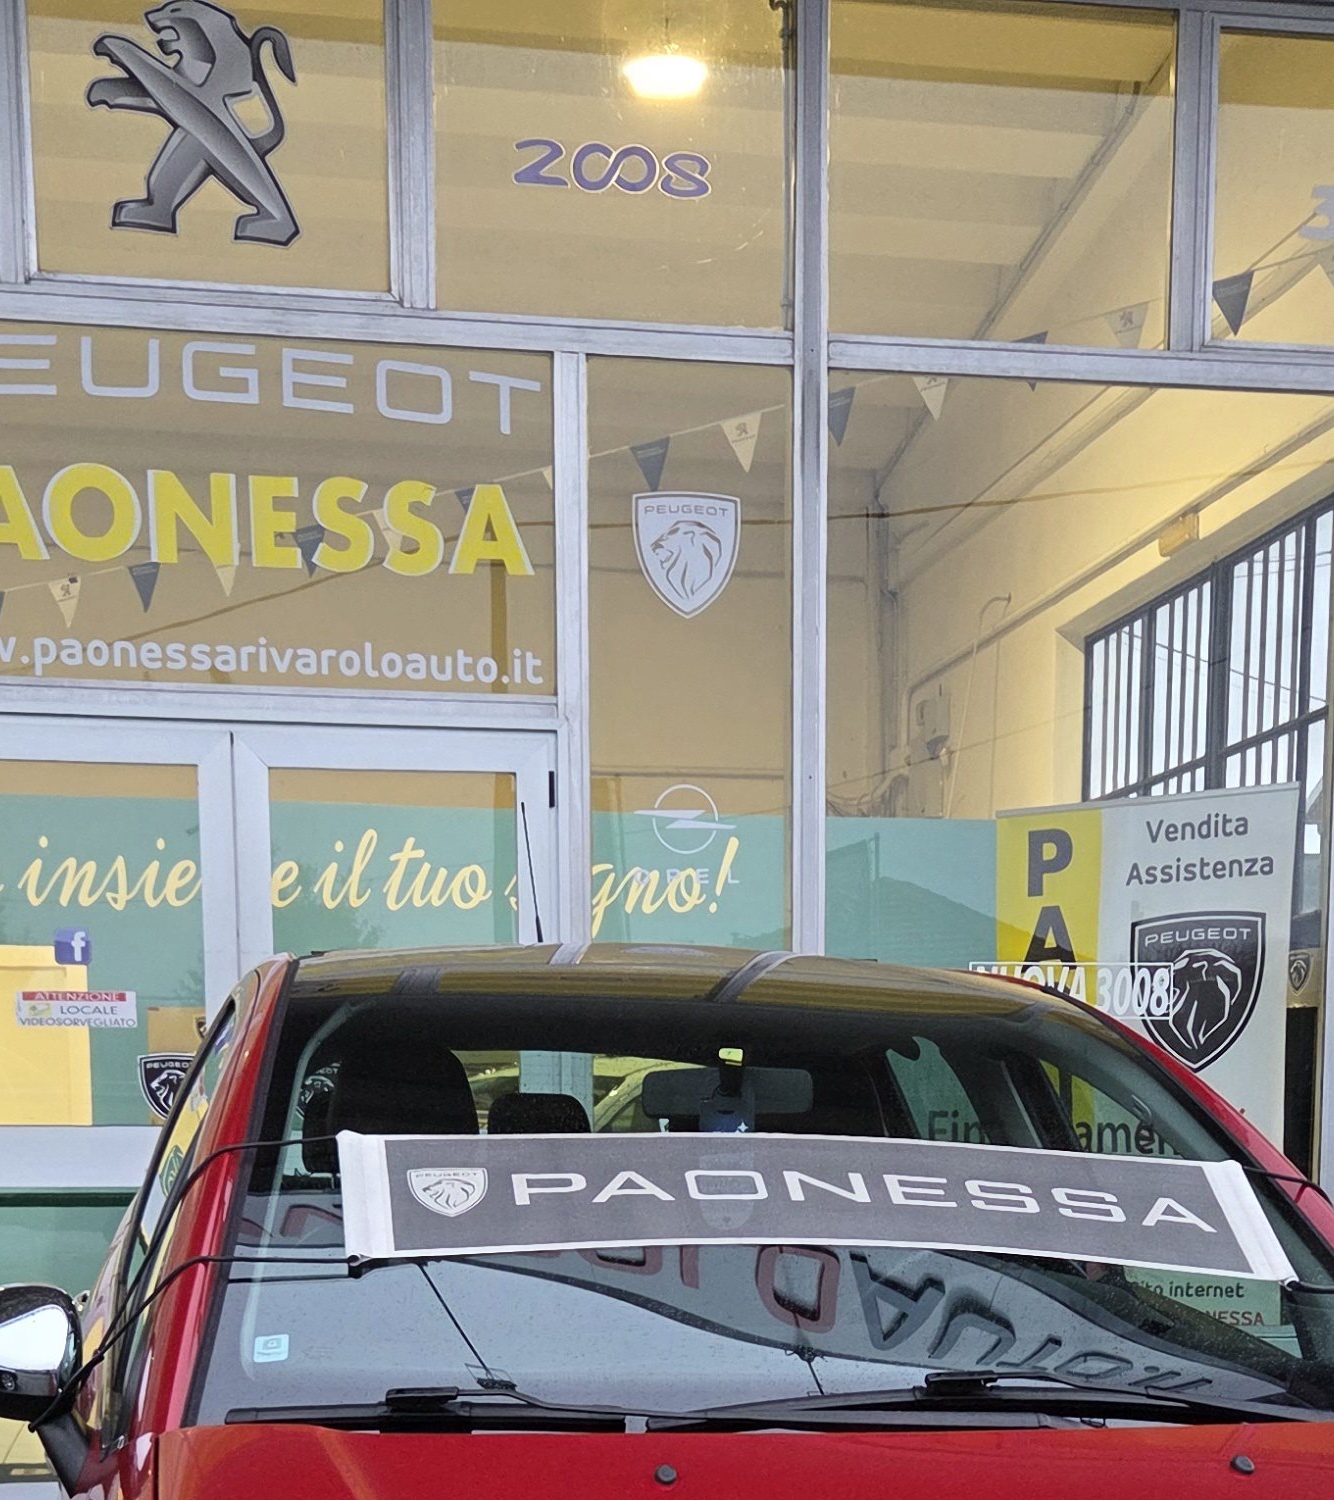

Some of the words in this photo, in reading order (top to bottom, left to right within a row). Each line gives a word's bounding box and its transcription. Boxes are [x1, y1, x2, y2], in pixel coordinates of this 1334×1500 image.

[513, 138, 712, 199] 2008
[643, 503, 729, 517] PEUGEOT
[1145, 813, 1250, 844] Vendita
[19, 835, 304, 911] insiee
[314, 828, 380, 909] il
[383, 836, 493, 911] tuo
[1125, 855, 1275, 887] Assistenza
[1144, 927, 1253, 947] PEUGEOT
[34, 991, 120, 1002] ATTENZIONE
[1097, 966, 1171, 1017] 3008
[60, 1005, 118, 1015] LOCALE
[19, 1017, 136, 1027] VIDEOSORVEGLIATO
[146, 1061, 192, 1069] PEUGEO
[511, 1167, 1218, 1233] PAONESSA
[1169, 1280, 1245, 1298] internet
